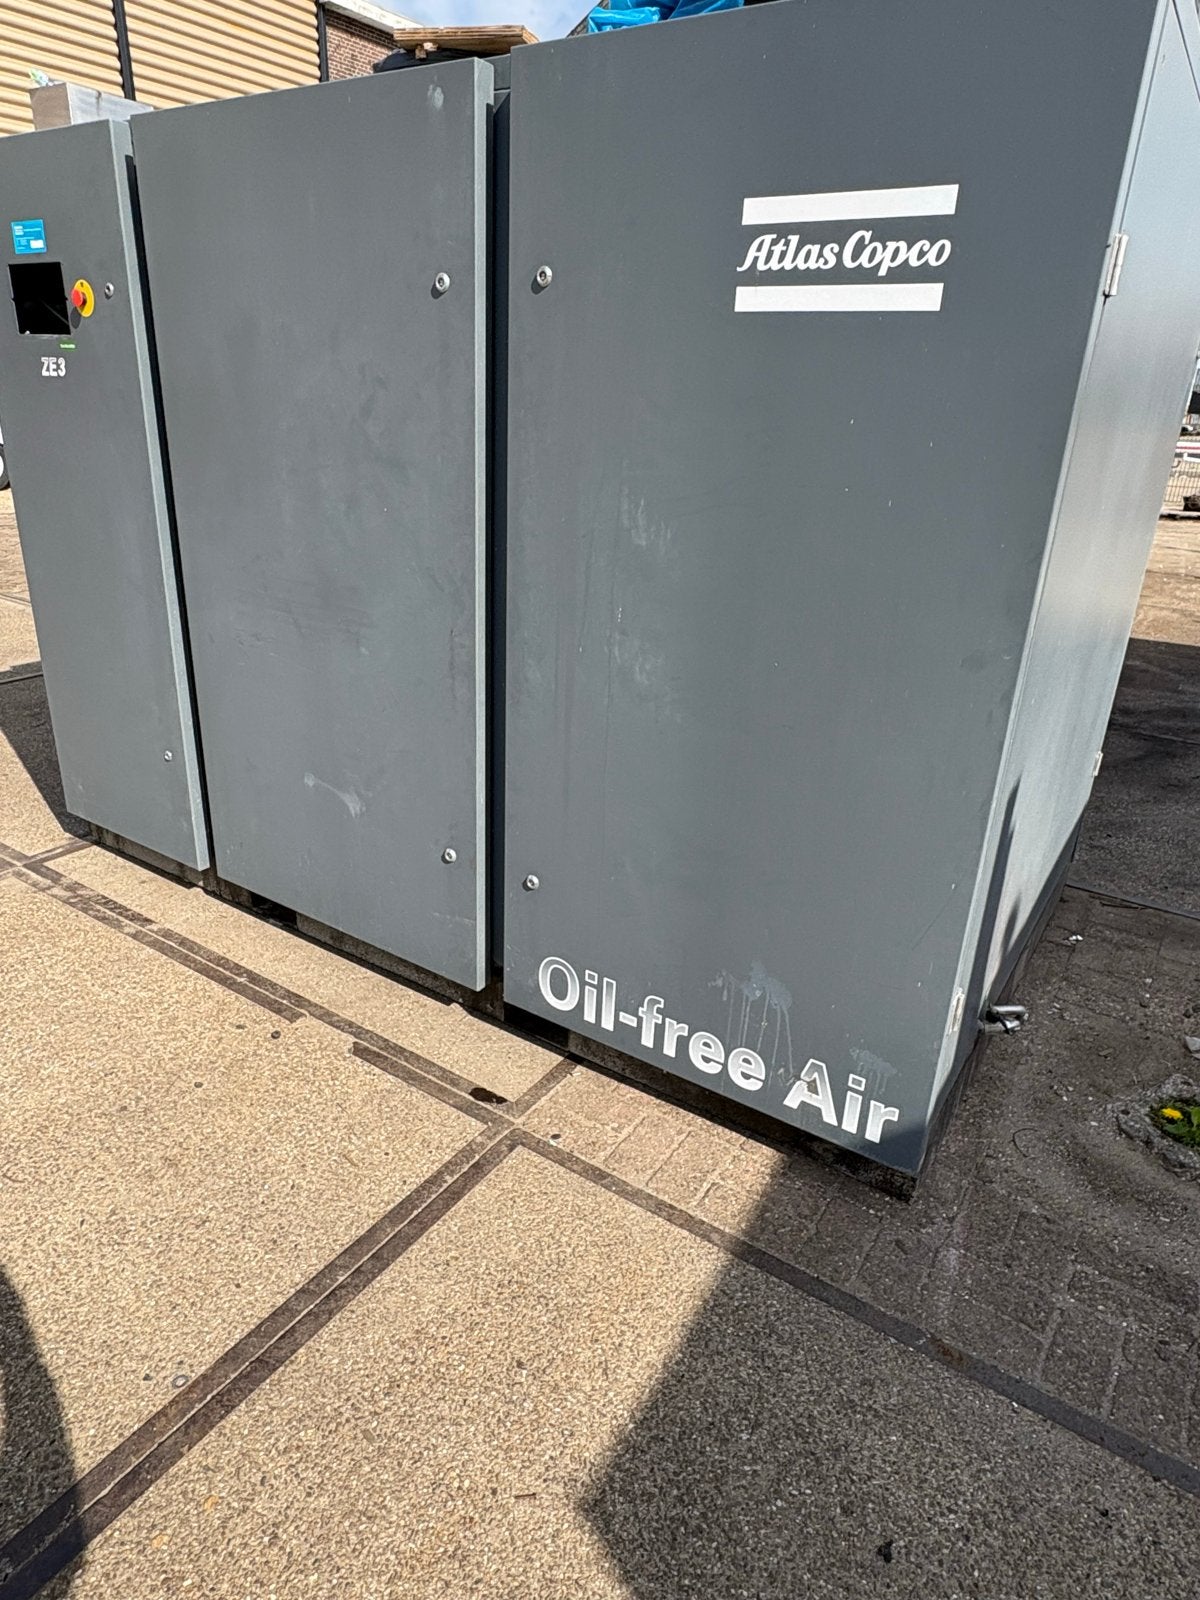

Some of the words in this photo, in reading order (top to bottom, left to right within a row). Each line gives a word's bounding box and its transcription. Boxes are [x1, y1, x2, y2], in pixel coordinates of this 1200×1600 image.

[736, 233, 840, 272] Atlas
[842, 230, 952, 276] Copco
[41, 356, 66, 377] ZE3
[538, 956, 766, 1091] Oil-free
[783, 1058, 900, 1144] Air
